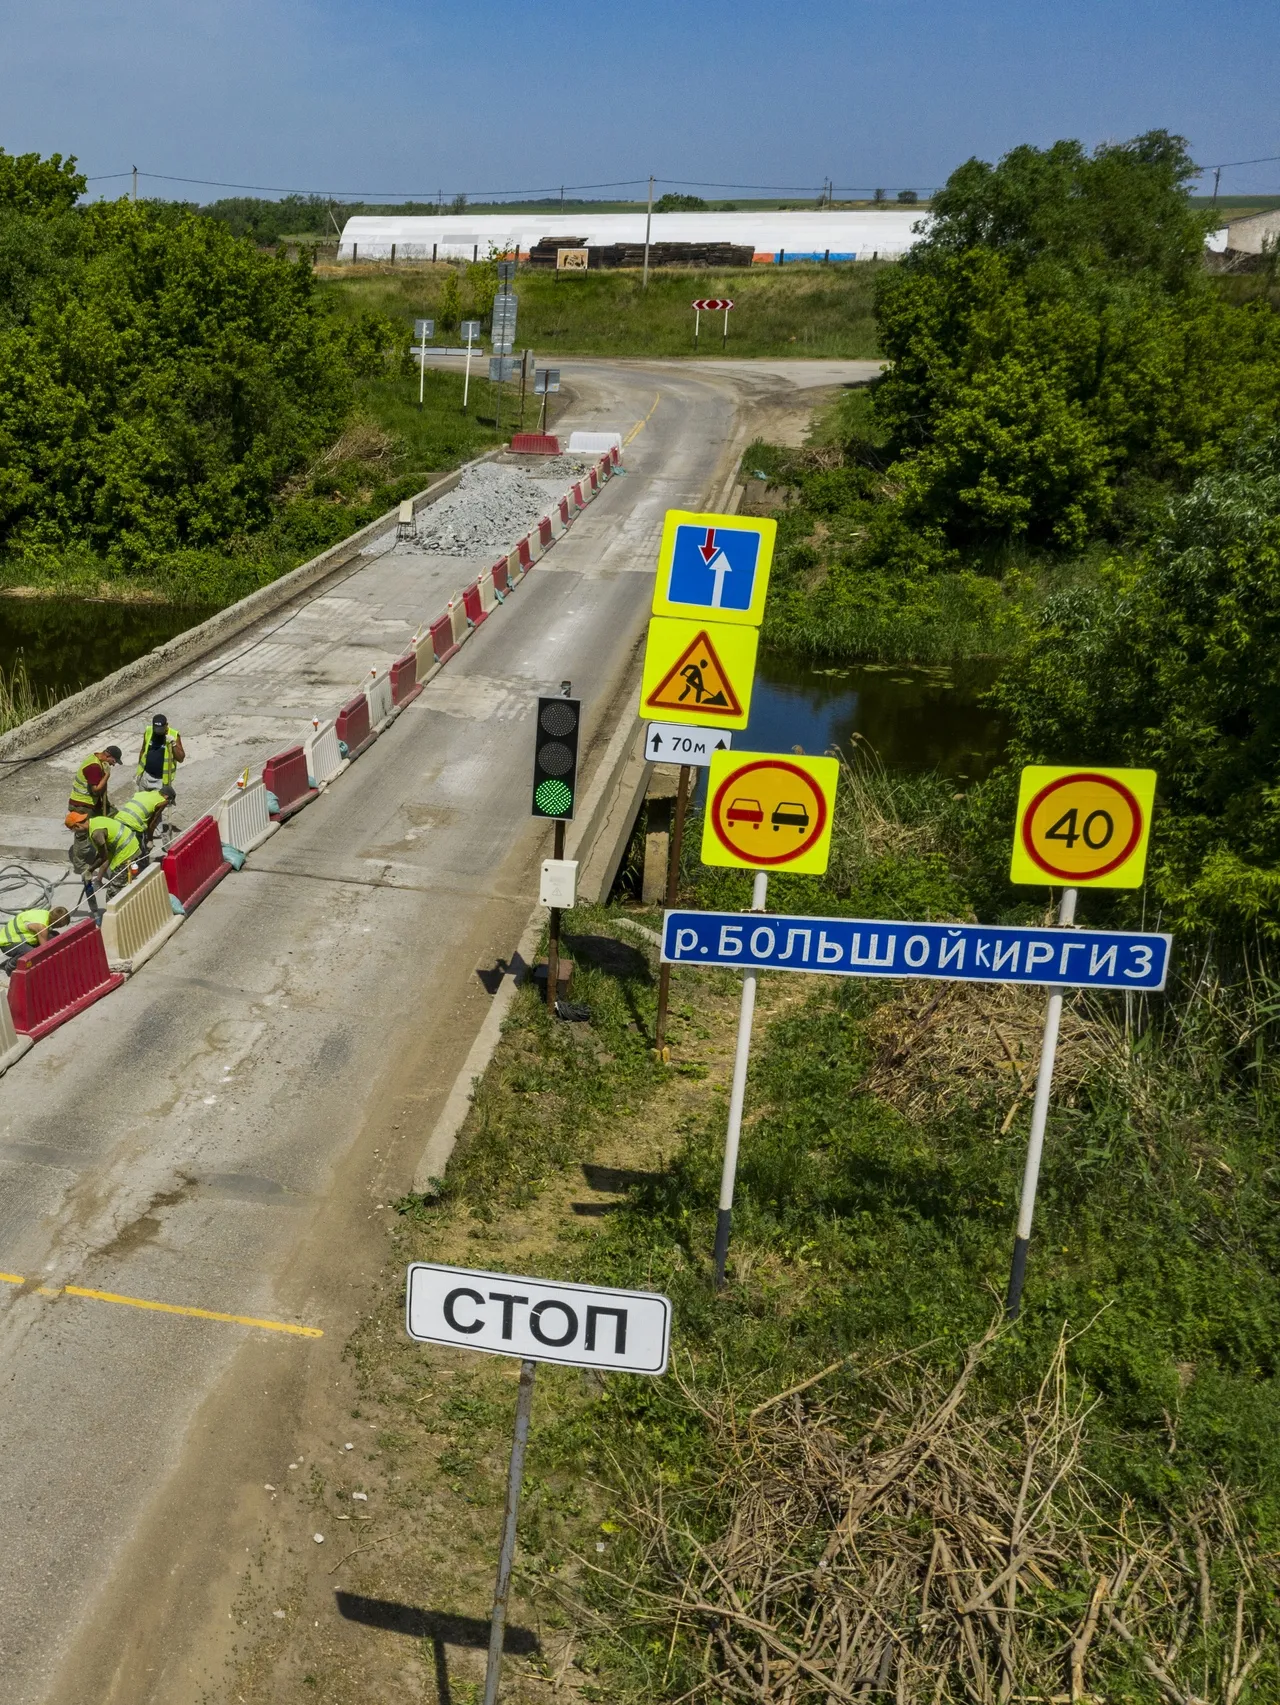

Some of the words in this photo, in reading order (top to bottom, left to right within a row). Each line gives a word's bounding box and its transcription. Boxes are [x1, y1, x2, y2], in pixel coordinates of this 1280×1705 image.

[672, 737, 706, 754] 70м
[1045, 808, 1115, 850] 40
[443, 1287, 628, 1355] СТОП
